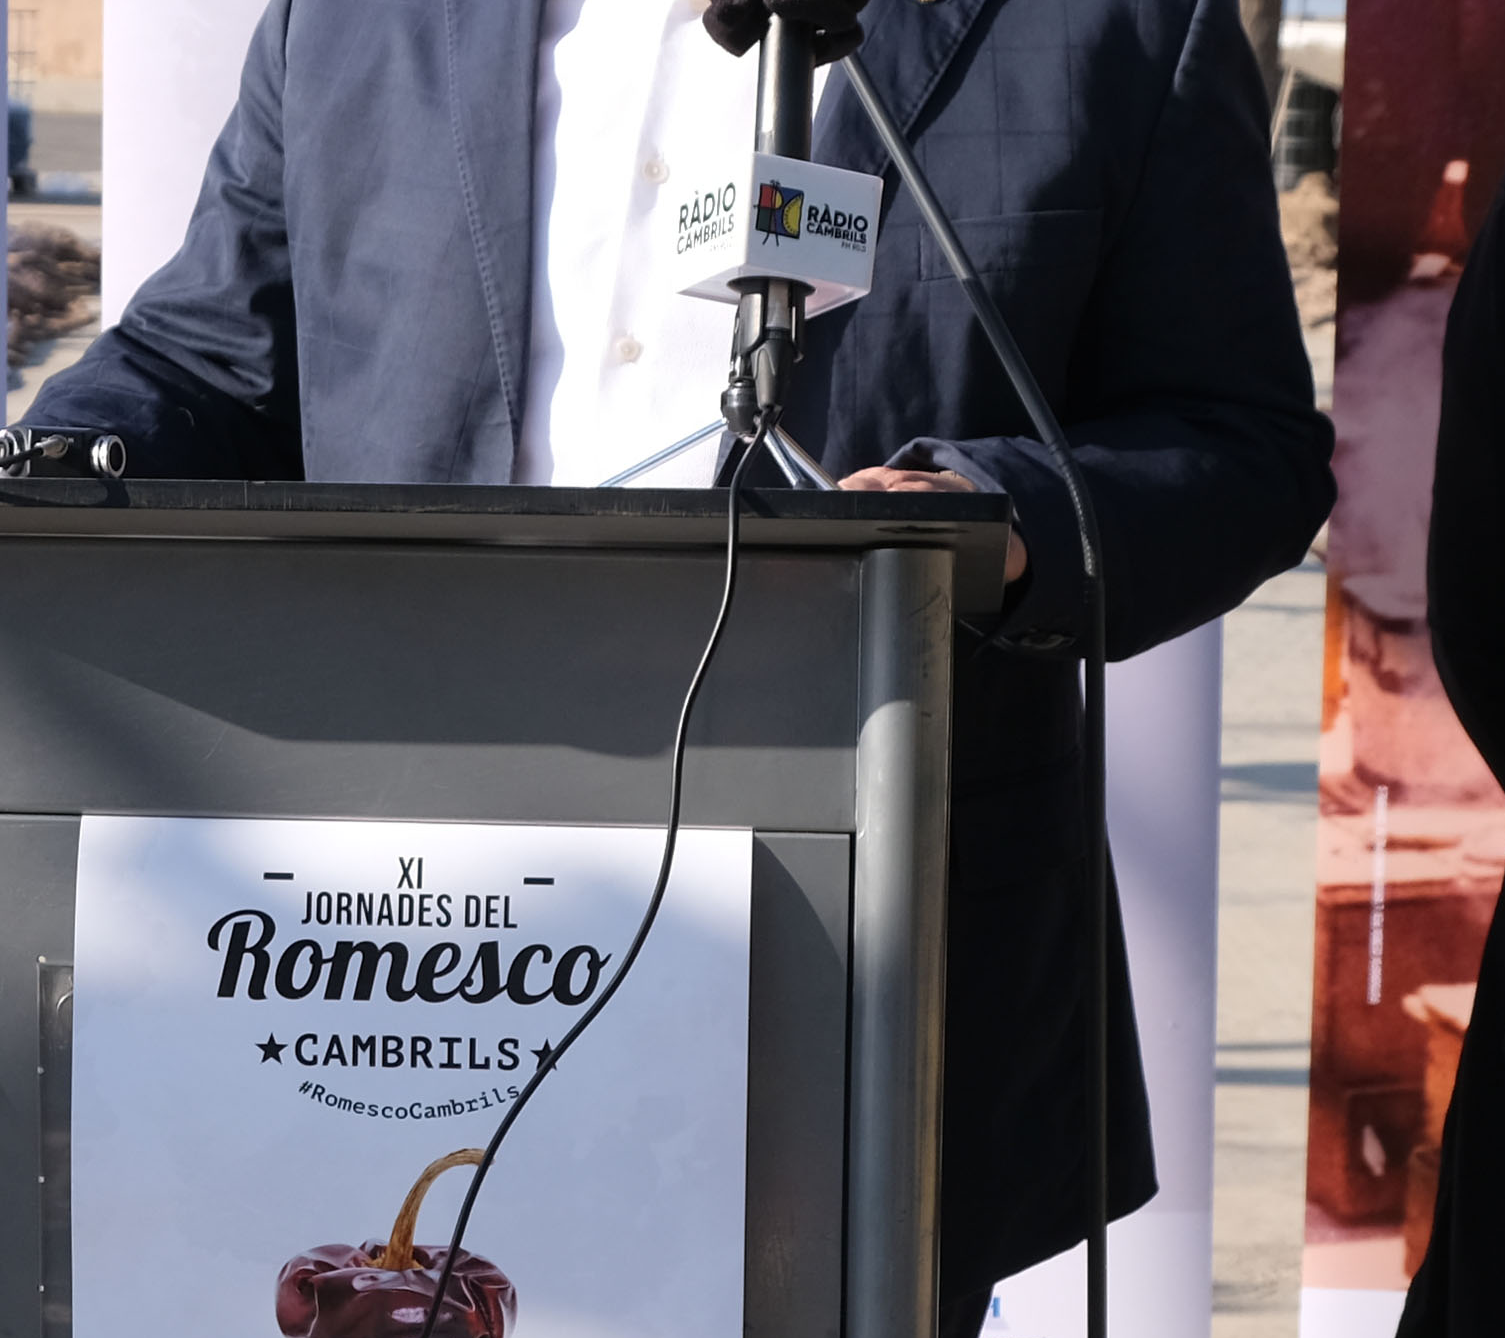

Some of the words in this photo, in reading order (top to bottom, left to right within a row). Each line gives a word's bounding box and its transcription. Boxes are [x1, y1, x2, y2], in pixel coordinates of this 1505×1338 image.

[679, 182, 736, 233] RÀDIO
[807, 203, 868, 232] RÀDIO
[677, 214, 735, 255] CAMBRILS
[806, 222, 867, 245] CAMBRILS
[398, 857, 423, 890] XI
[302, 891, 452, 929] JORNADES
[464, 896, 518, 929] DEL
[207, 909, 612, 1006] Romesco
[294, 1033, 521, 1071] CAMBRILS
[298, 1079, 521, 1120] #RomescoCambrils
